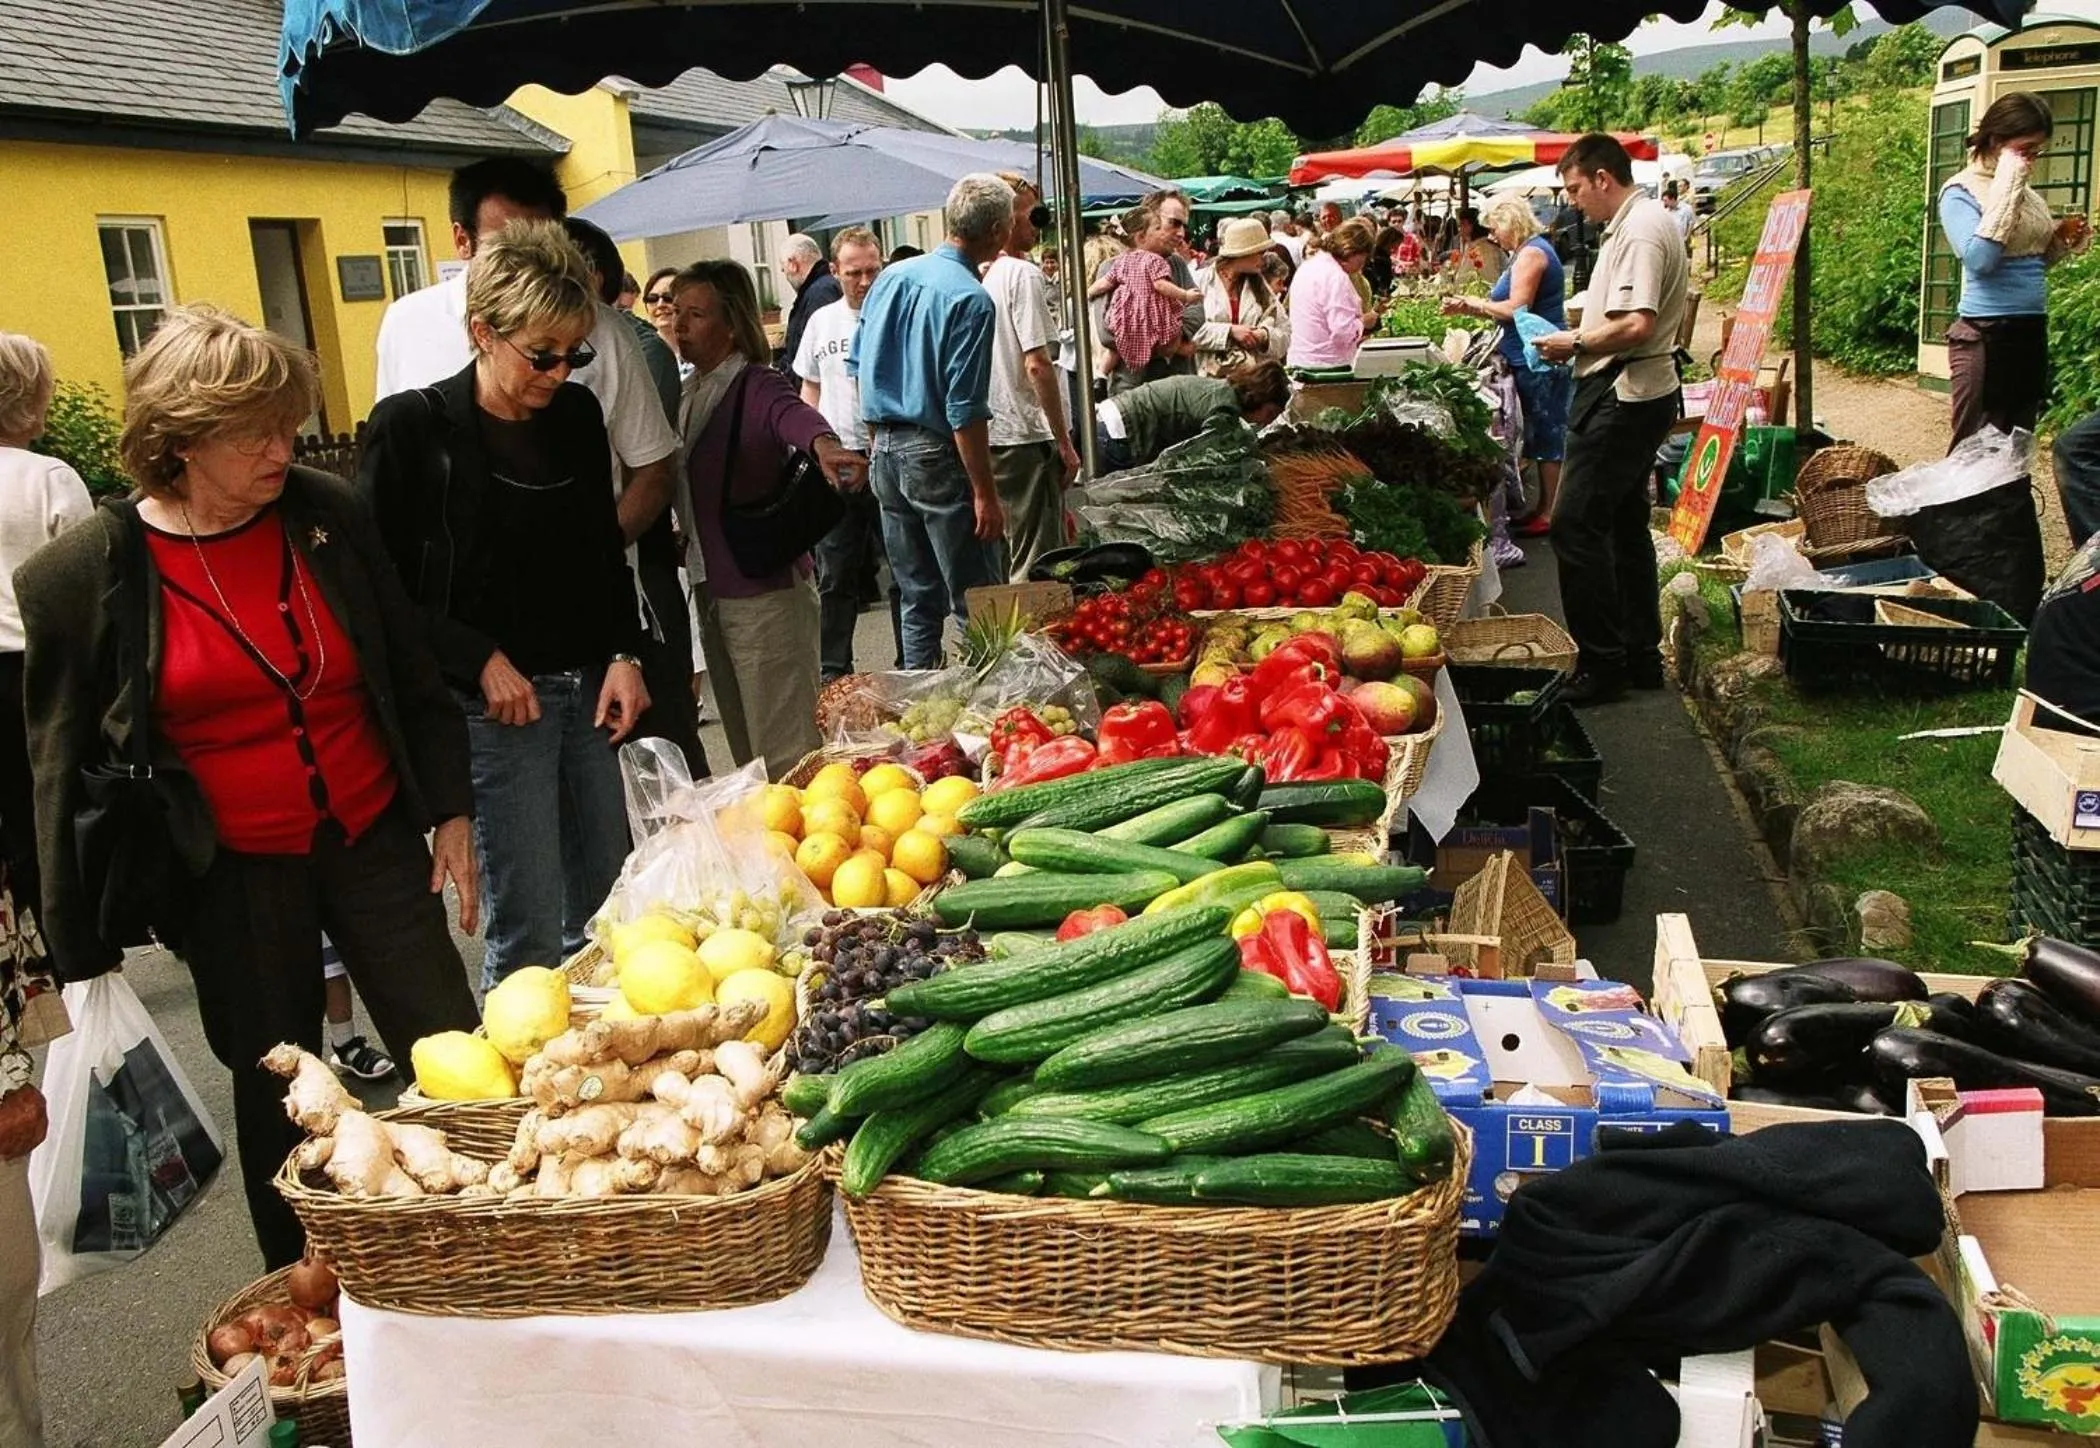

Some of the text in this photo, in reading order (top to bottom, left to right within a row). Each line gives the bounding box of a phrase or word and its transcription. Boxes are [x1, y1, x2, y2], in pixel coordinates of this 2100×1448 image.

[2023, 50, 2081, 65] Telephone
[1518, 1118, 1563, 1132] CLASS
[1532, 1135, 1546, 1167] I
